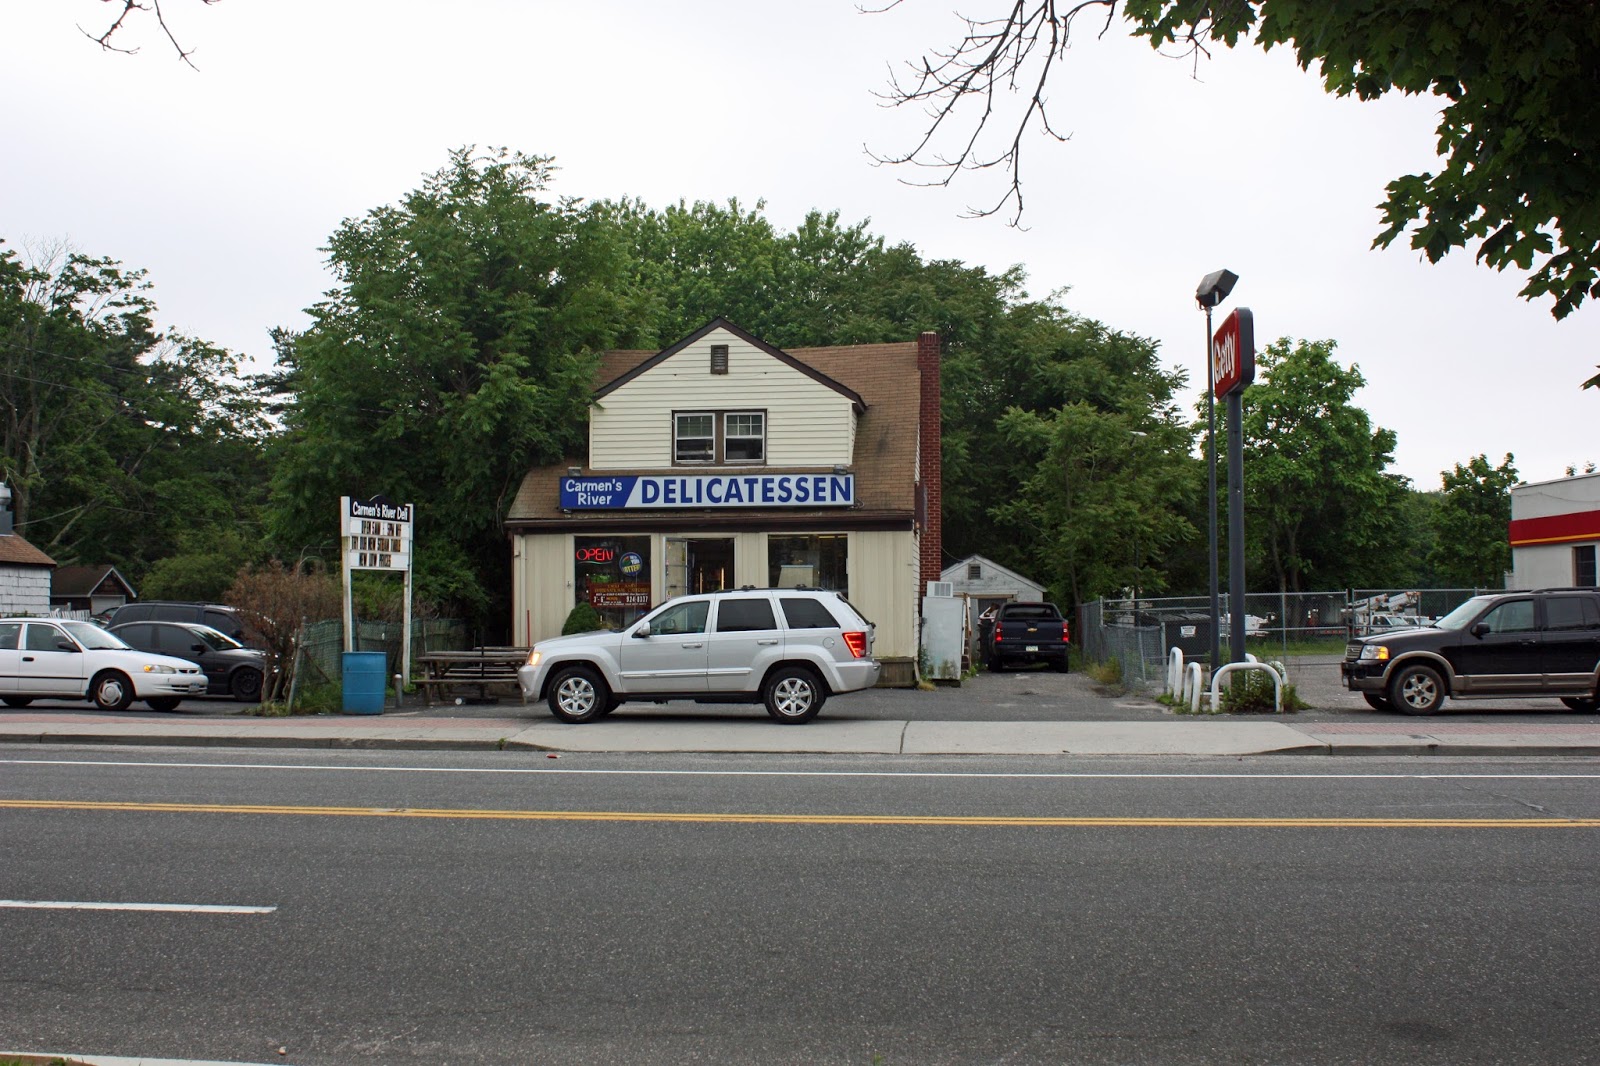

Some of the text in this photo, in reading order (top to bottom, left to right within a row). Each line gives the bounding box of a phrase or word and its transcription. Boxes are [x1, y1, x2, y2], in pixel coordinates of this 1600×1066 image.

[1213, 331, 1235, 384] Getty
[565, 478, 623, 492] Carmen's
[641, 476, 851, 504] DELICATESSEN
[577, 492, 612, 505] River
[352, 501, 408, 520] Carmen's River Deli
[576, 548, 613, 561] OPEN
